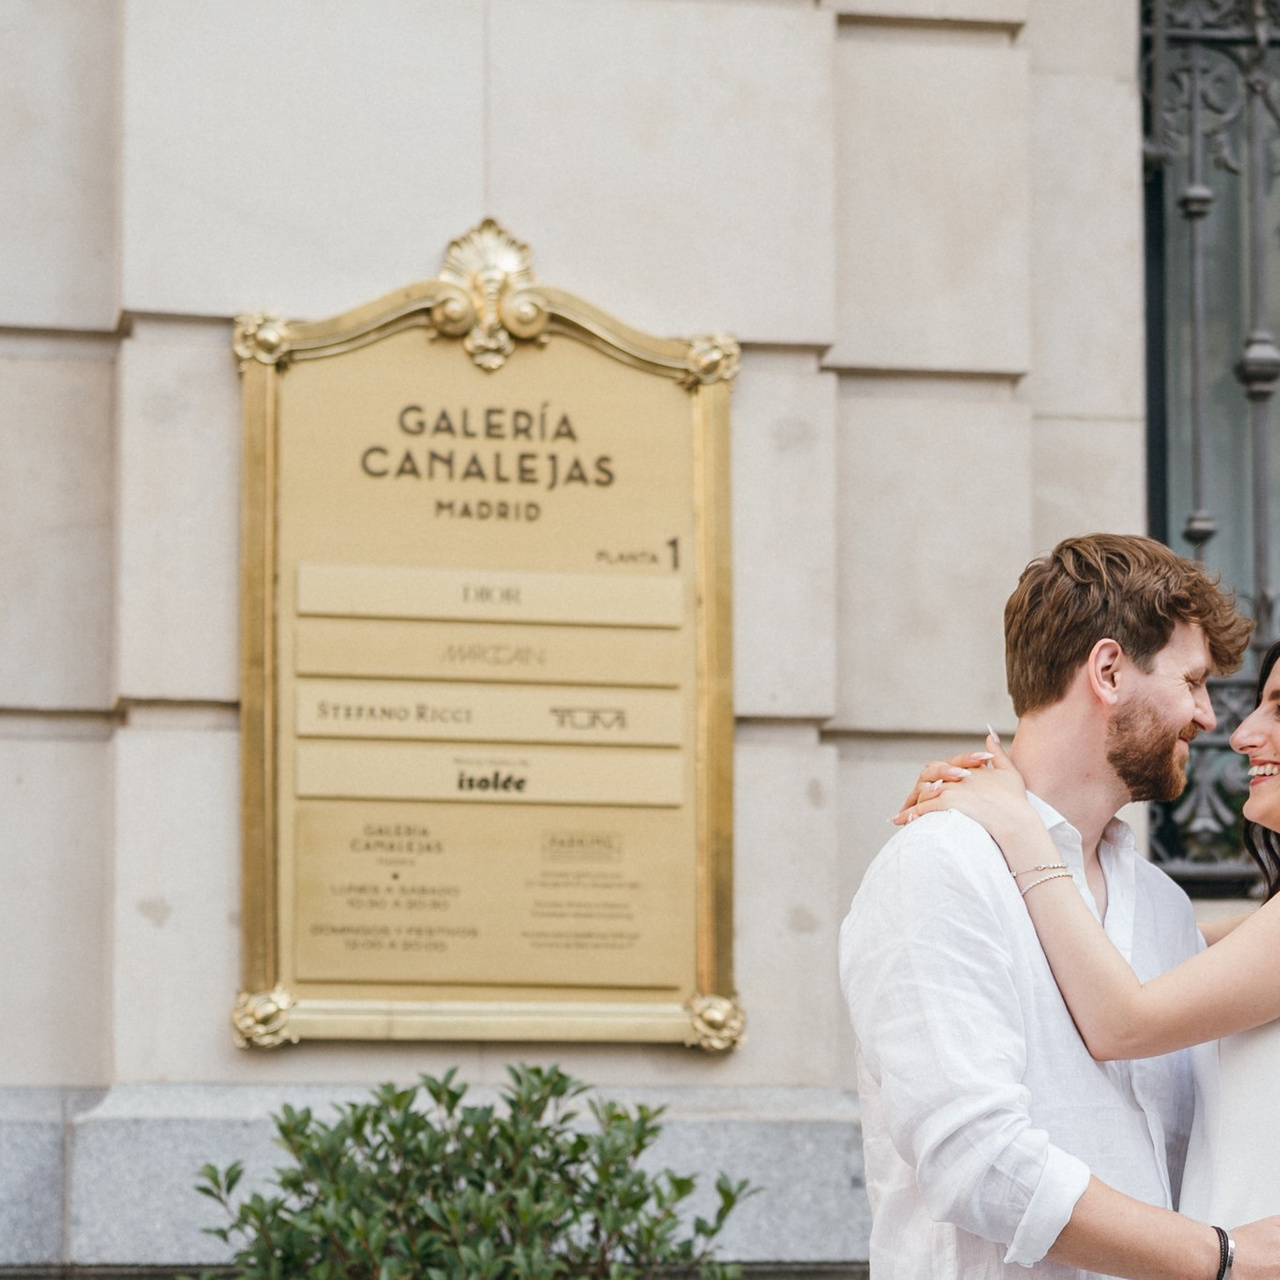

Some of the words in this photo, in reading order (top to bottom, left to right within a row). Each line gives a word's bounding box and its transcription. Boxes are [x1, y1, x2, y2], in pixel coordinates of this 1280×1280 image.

[399, 401, 578, 443] GALERÍA
[361, 445, 615, 490] CANALEJAS
[435, 499, 541, 521] MADRID
[596, 550, 659, 566] PLANTA
[666, 537, 681, 571] 1
